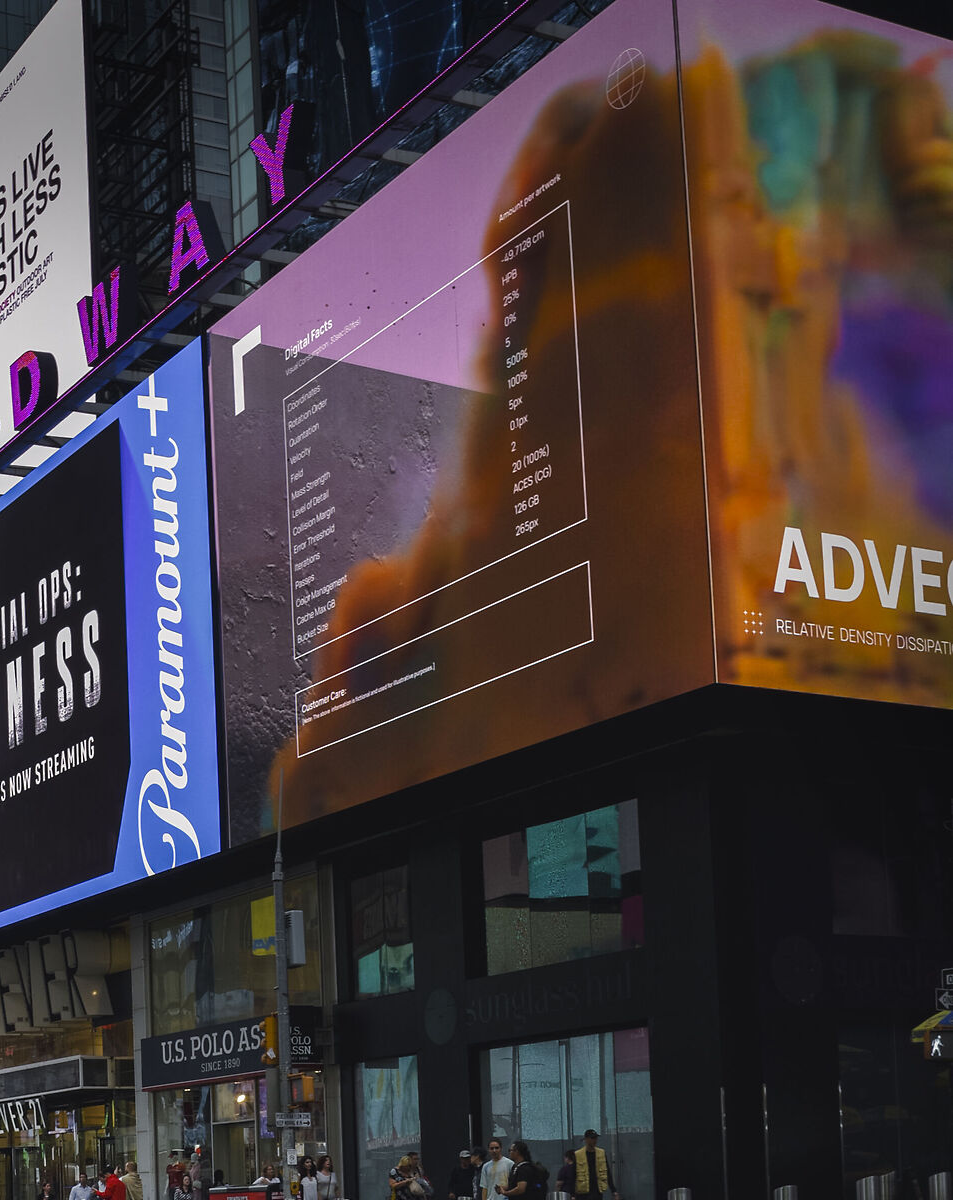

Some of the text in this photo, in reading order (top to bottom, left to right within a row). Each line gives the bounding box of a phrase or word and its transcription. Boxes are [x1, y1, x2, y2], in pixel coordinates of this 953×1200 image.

[11, 129, 55, 208] LIVE
[11, 163, 61, 244] LESS
[499, 173, 561, 222] Amount per artwork
[532, 230, 545, 244] cm
[503, 288, 520, 308] 25%
[504, 311, 517, 328] 0%
[285, 333, 309, 361] Digital
[311, 319, 333, 342] Facts
[505, 336, 511, 349] 5
[506, 348, 529, 369] 500%
[507, 369, 528, 390] 100%
[312, 398, 328, 416] Order
[509, 396, 523, 411] 5px
[289, 446, 311, 466] Velocity
[511, 440, 517, 452] 2
[512, 460, 522, 474] 20
[513, 464, 552, 494] ACES (CG)
[316, 506, 336, 524] Margin
[514, 494, 539, 516] 126 GB
[307, 524, 336, 546] Threshold
[515, 517, 539, 538] 265px
[773, 526, 953, 617] ADVE
[39, 560, 81, 625] OPS:
[296, 610, 315, 626] Cache
[315, 604, 327, 618] Max
[316, 622, 329, 637] Size
[776, 618, 953, 656] RELATIVE DENSITY DISSIPATI
[301, 688, 347, 714] Customer Care:
[9, 767, 31, 798] NOW
[35, 736, 95, 786] STREAMING
[161, 1024, 265, 1064] U.S. POLO AS
[291, 1046, 313, 1055] SSN.
[201, 1058, 241, 1073] SINCE 1890
[29, 1098, 46, 1130] 21
